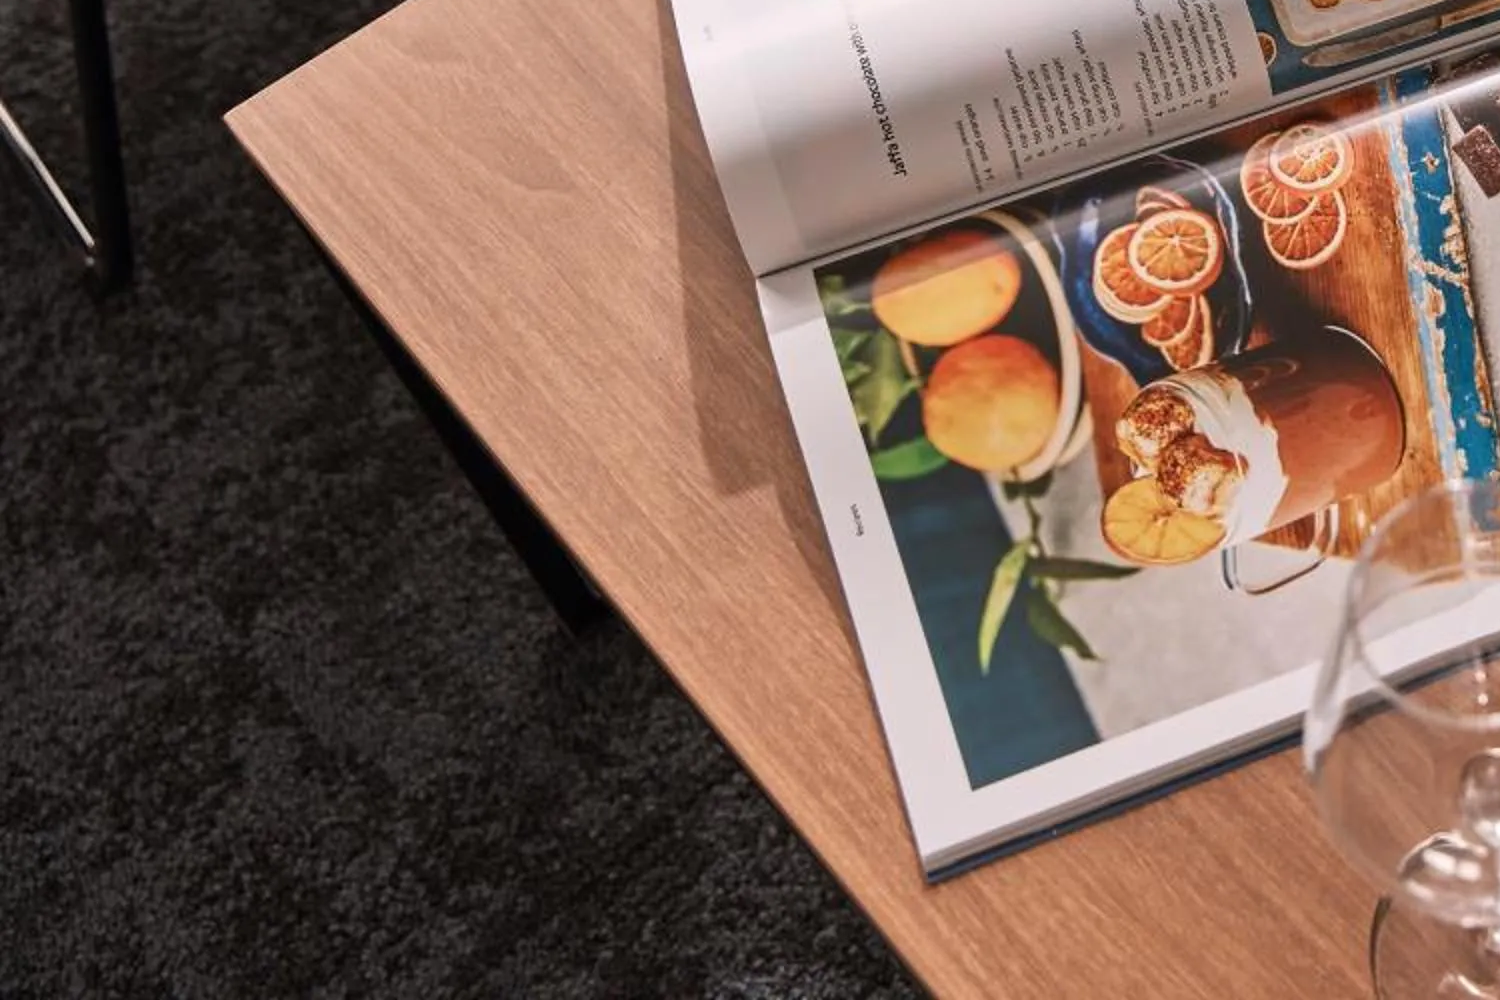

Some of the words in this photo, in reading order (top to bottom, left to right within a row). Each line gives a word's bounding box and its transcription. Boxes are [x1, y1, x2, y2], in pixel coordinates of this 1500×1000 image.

[859, 56, 886, 114] chocolate
[878, 116, 895, 141] hot
[887, 143, 907, 175] Jaffa
